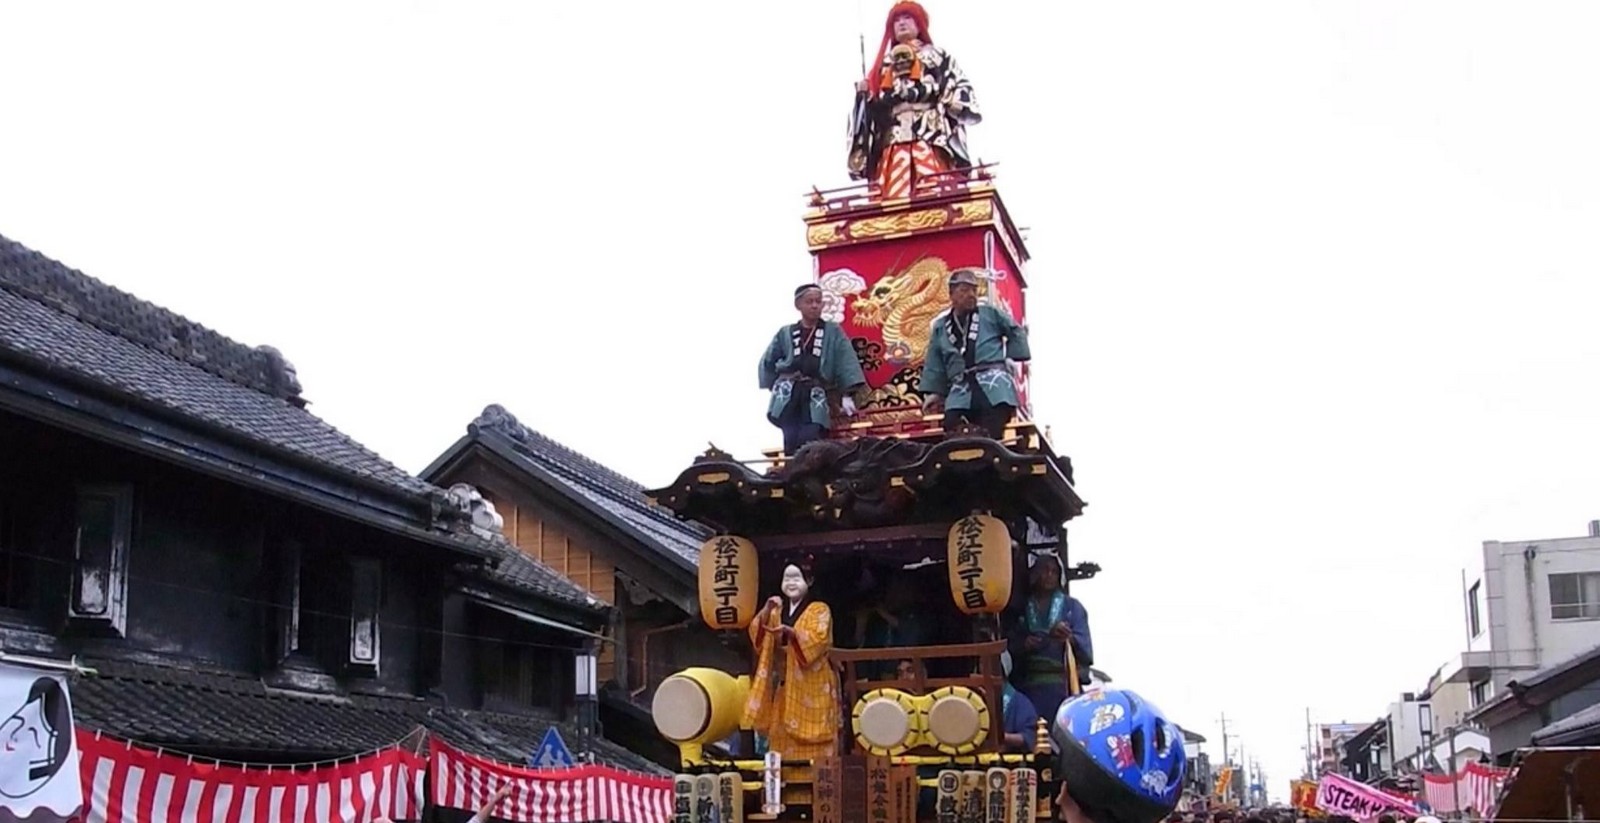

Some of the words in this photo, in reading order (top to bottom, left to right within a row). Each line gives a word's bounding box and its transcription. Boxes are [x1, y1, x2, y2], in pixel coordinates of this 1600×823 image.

[713, 537, 740, 624] 松江町一丁目
[957, 517, 987, 608] 松江町一丁目
[1324, 784, 1371, 816] STEAK
